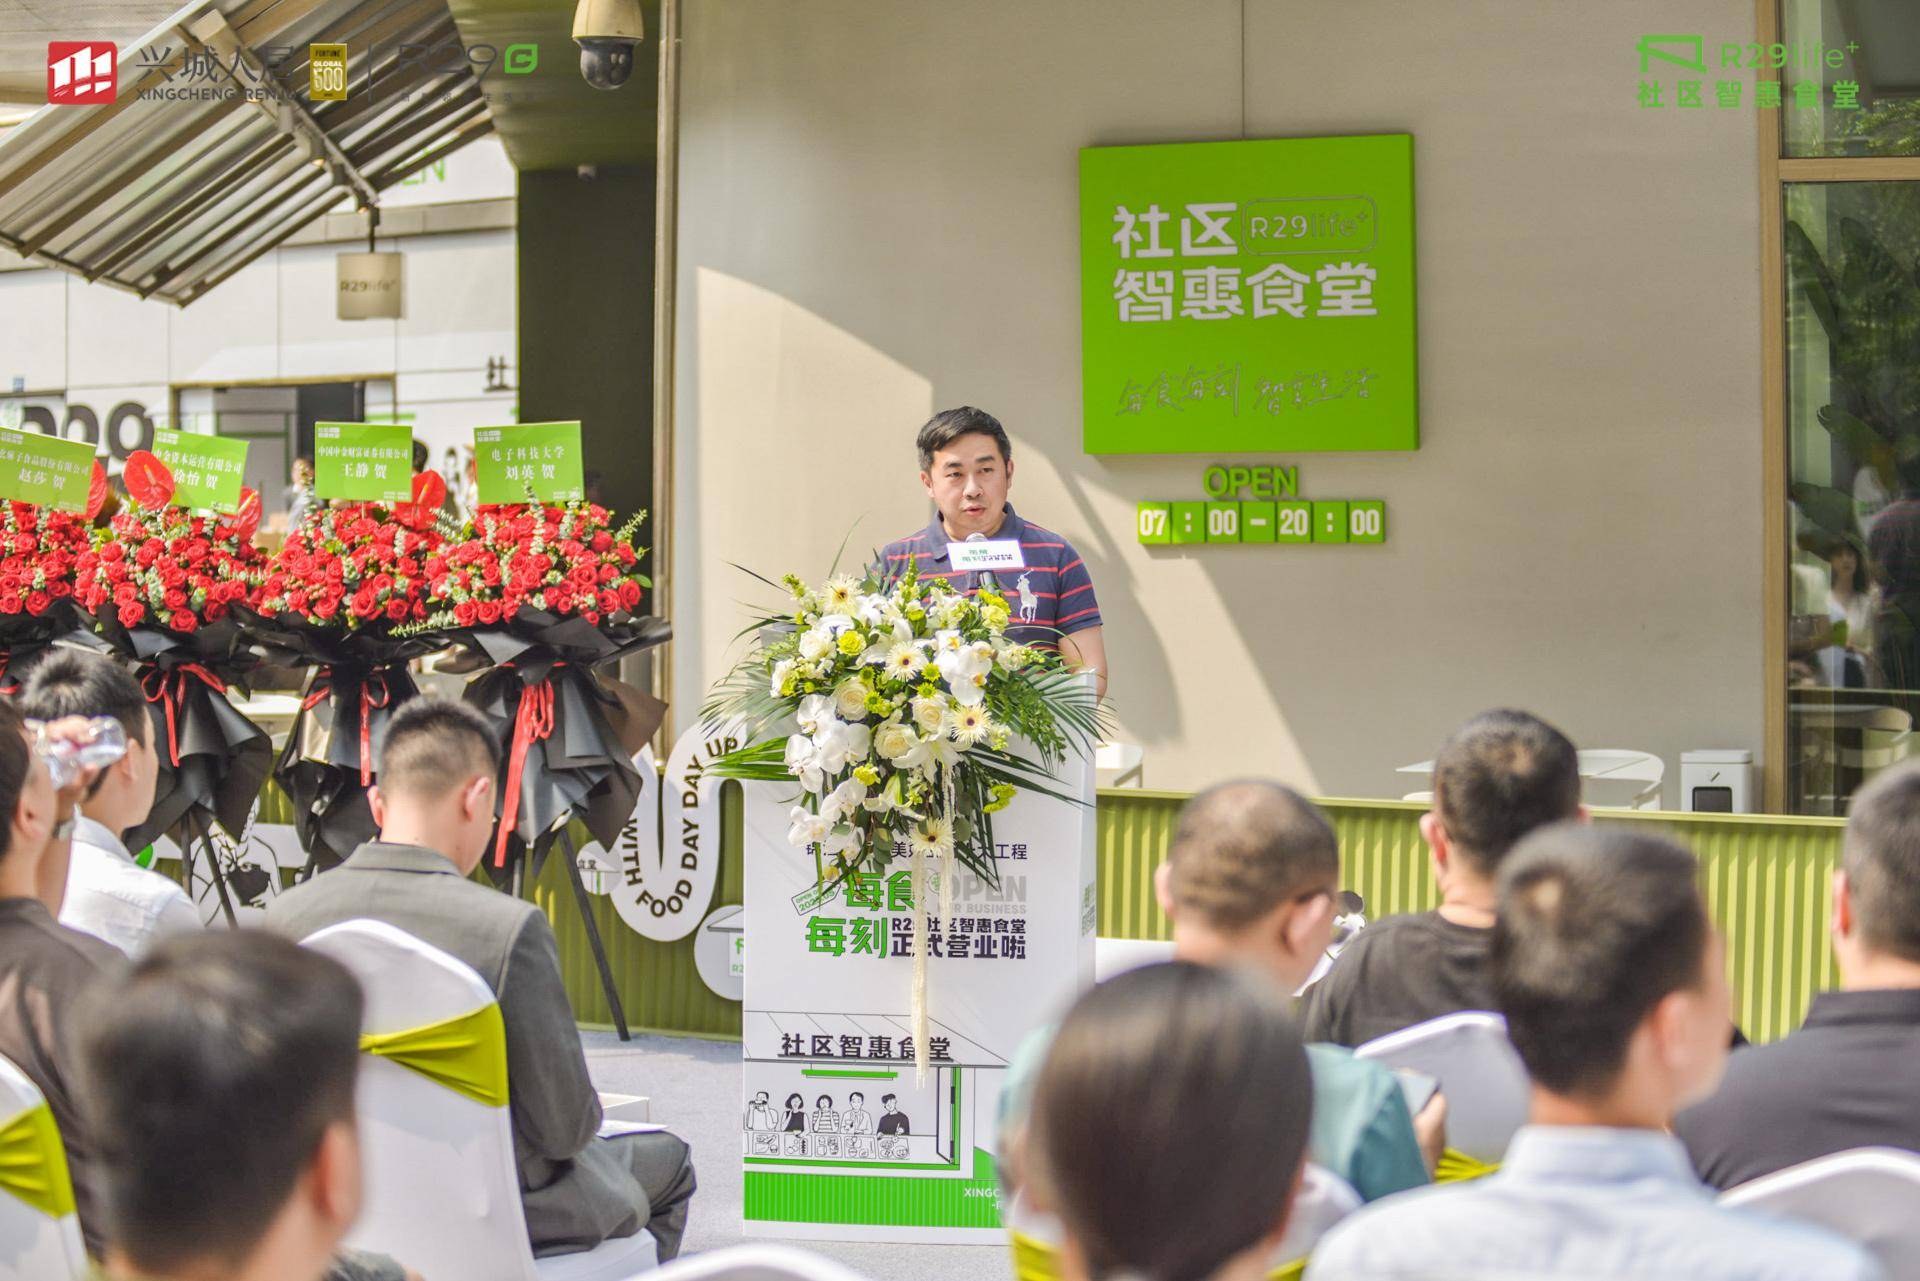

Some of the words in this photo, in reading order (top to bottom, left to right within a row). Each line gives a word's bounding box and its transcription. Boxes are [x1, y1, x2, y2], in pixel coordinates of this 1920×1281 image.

[1112, 201, 1238, 259] 社区
[1113, 261, 1378, 322] 智惠食堂
[491, 445, 565, 462] 电子科技大学
[1203, 464, 1298, 498] OPEN
[705, 737, 738, 758] UP
[682, 754, 705, 808] DAY
[622, 818, 643, 886] WITH
[681, 818, 699, 870] DAY
[635, 878, 692, 918] FOOD
[966, 903, 1027, 914] BUSINESS
[805, 915, 888, 959] 每刻
[782, 1033, 951, 1061] 社区智惠食堂
